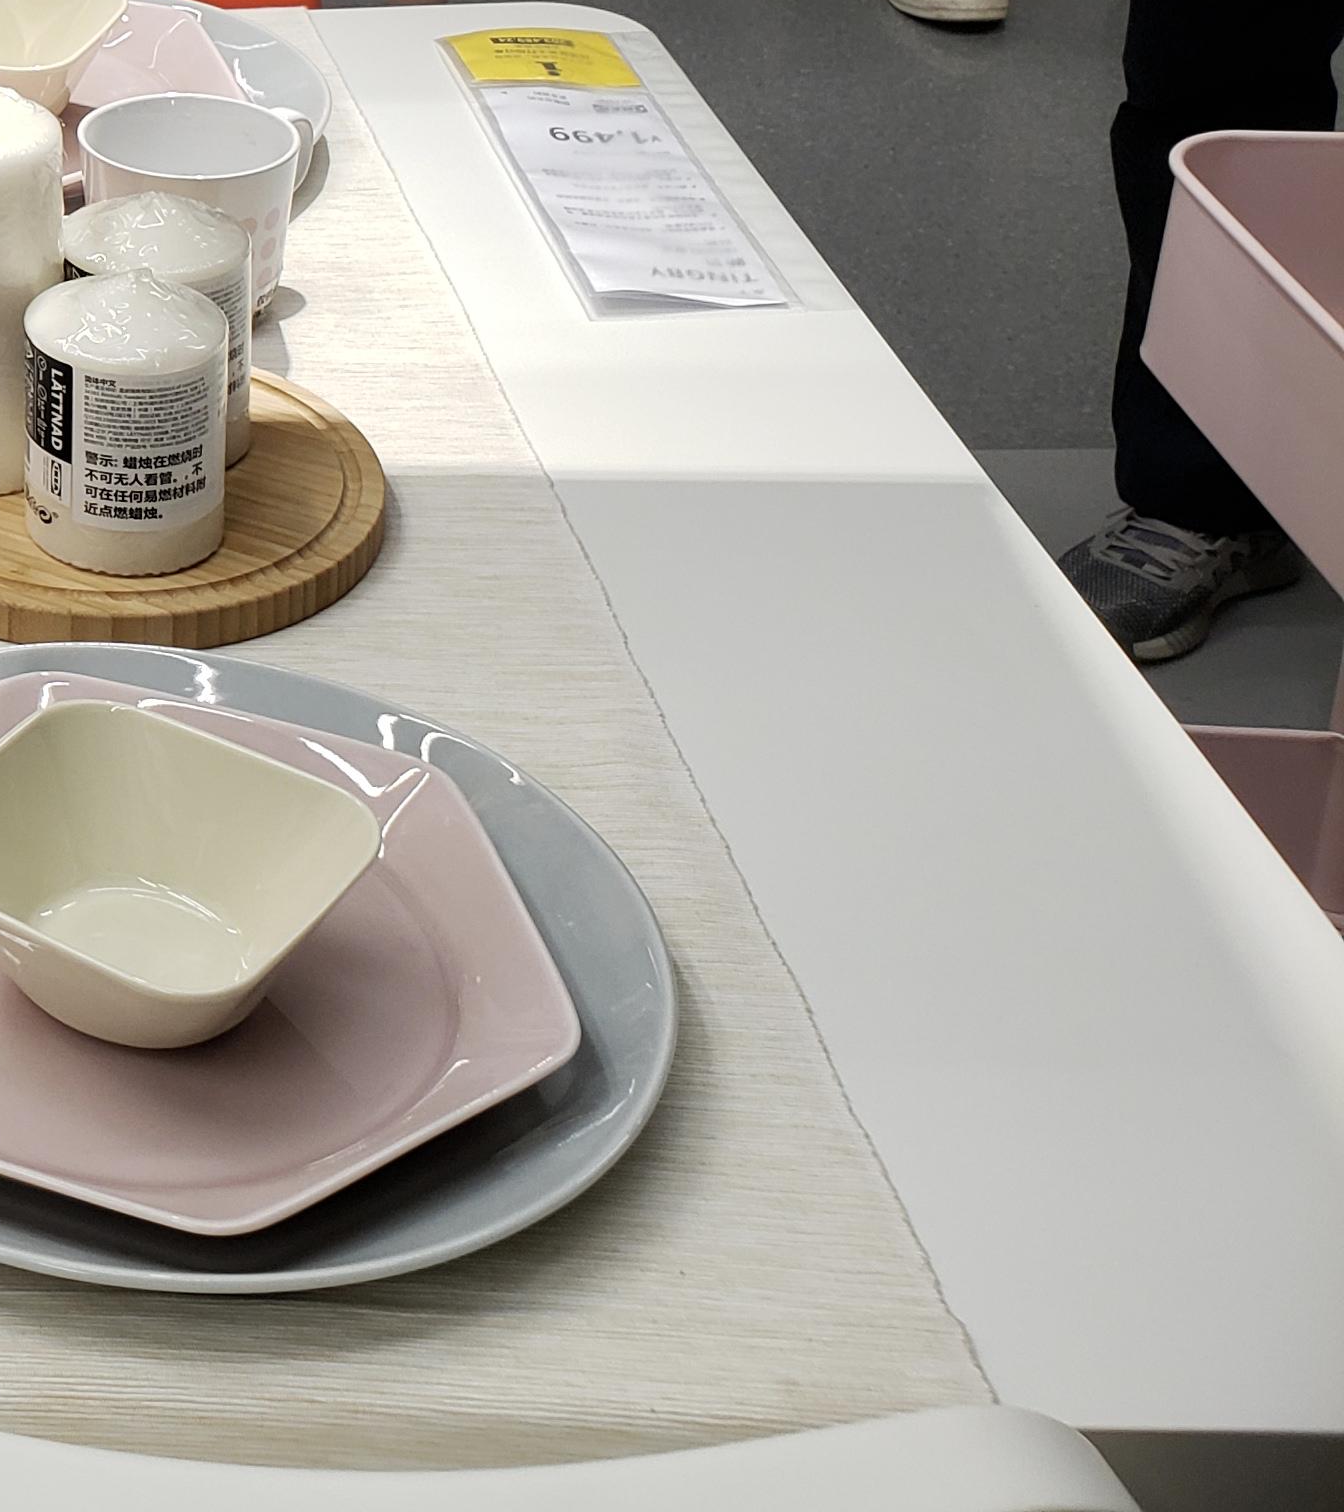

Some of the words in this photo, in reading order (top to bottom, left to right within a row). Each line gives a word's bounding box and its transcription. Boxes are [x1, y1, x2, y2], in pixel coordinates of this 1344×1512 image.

[51, 368, 66, 451] LÄTTNAD
[84, 503, 163, 520] 近点燃蜡烛。
